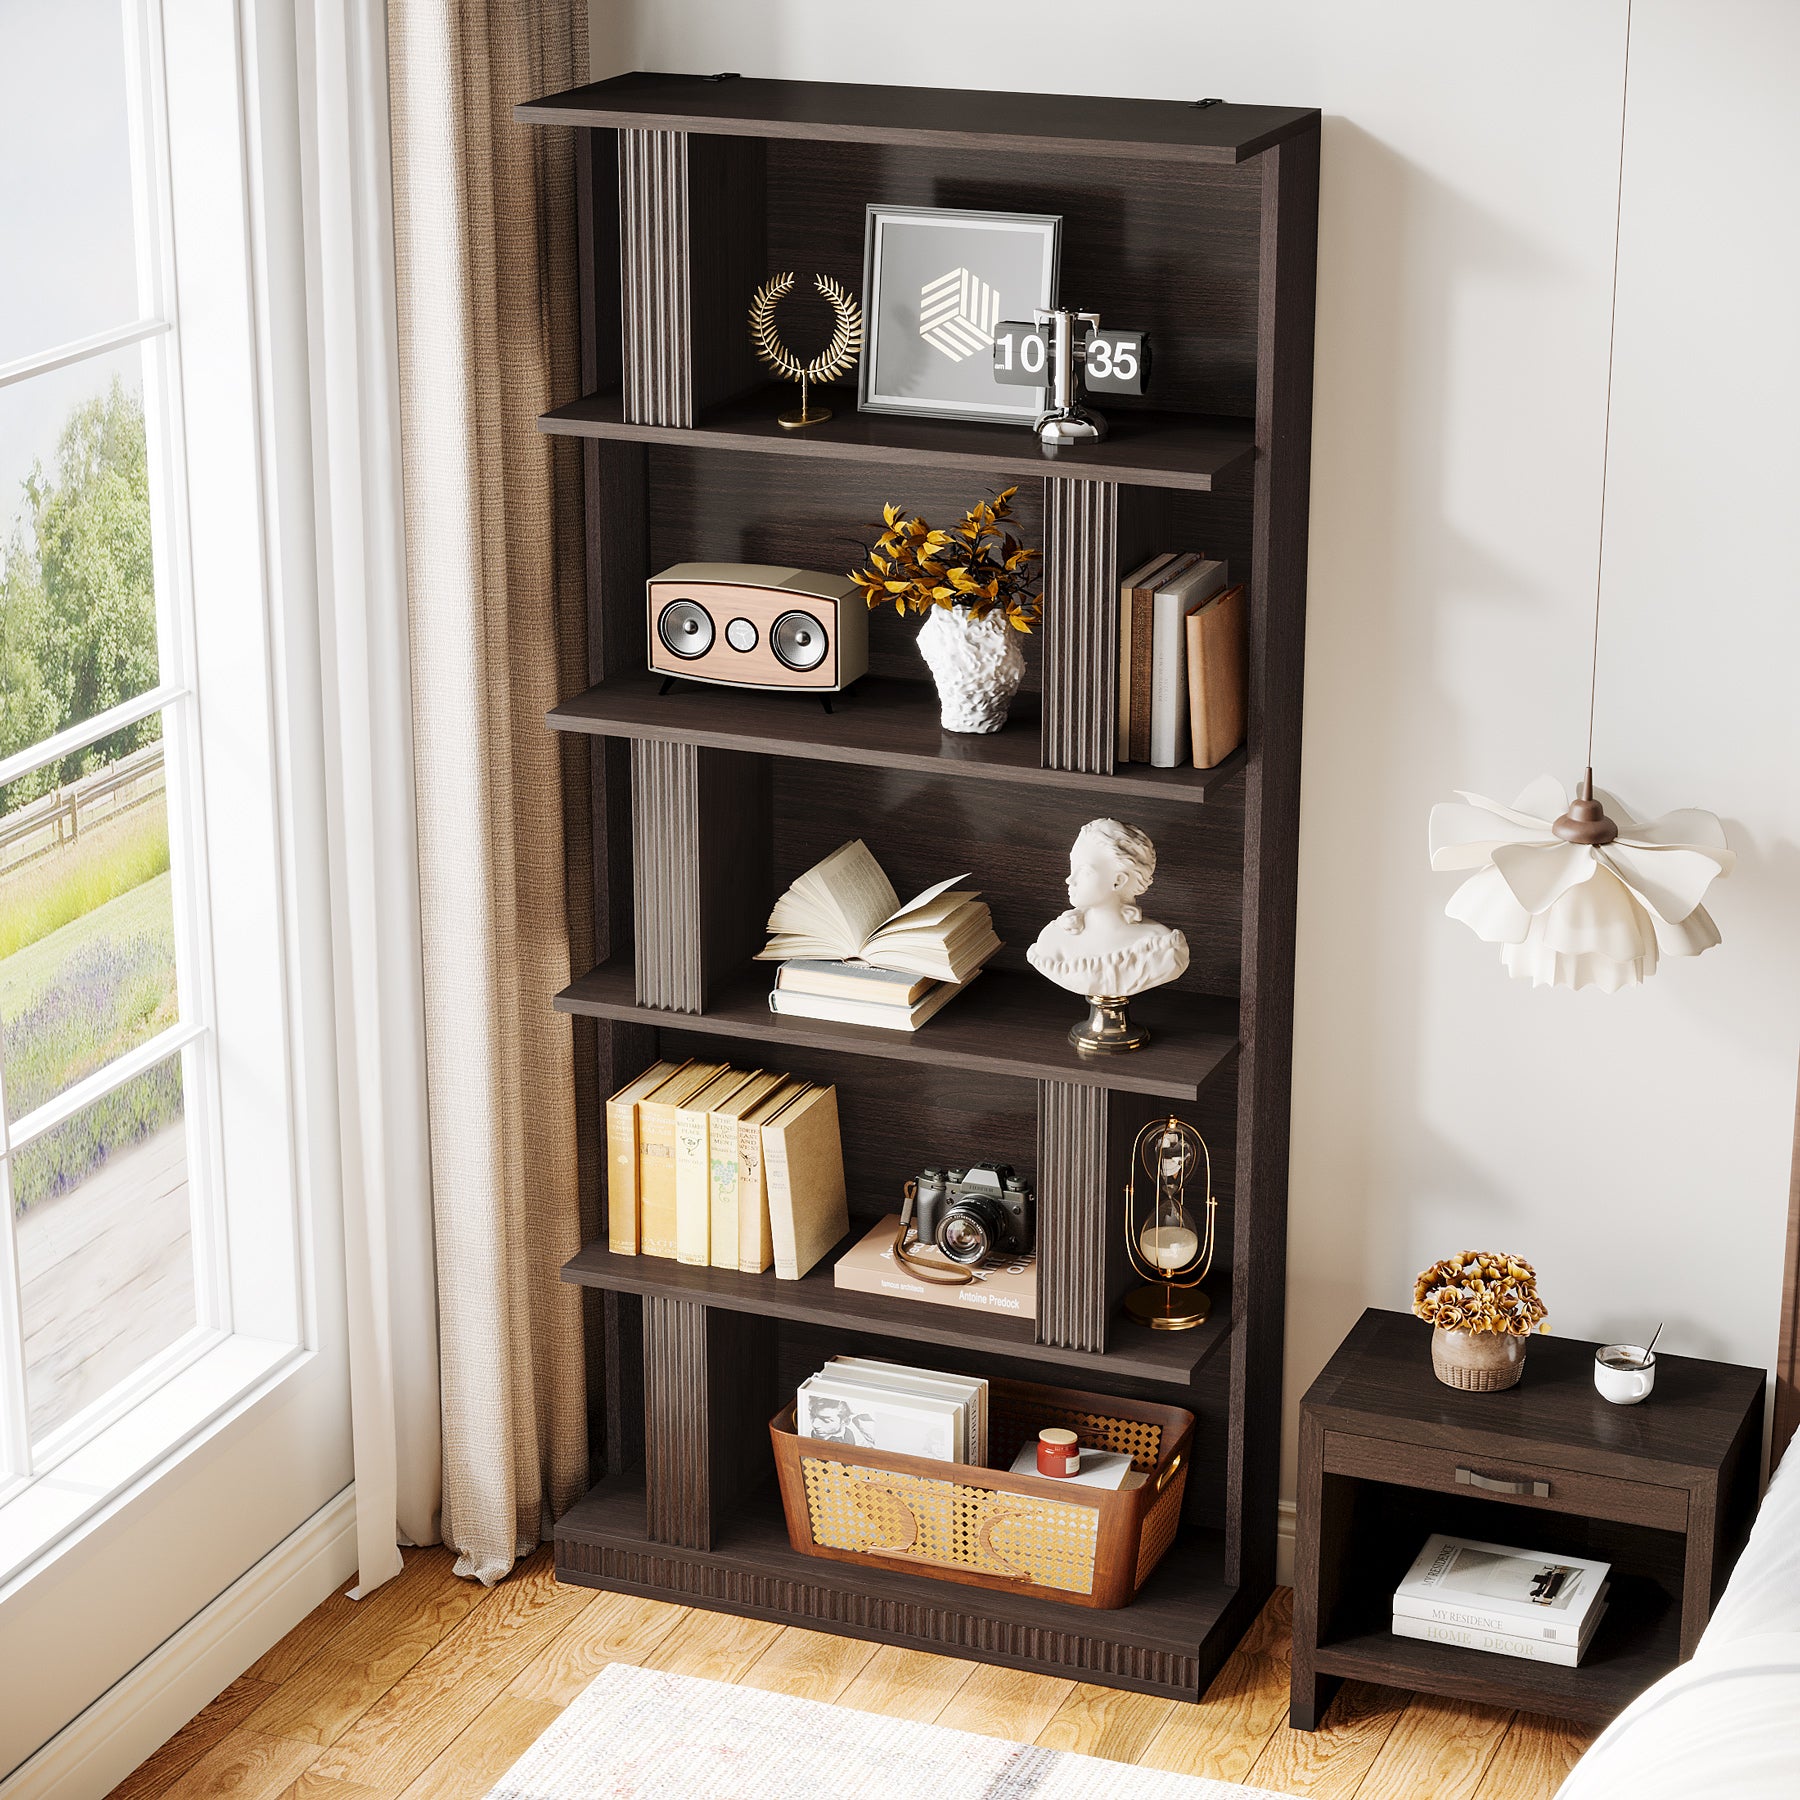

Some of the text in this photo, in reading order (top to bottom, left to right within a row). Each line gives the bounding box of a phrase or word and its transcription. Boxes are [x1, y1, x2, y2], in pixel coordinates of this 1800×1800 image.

[996, 333, 1138, 380] 10 35
[958, 1289, 1020, 1309] Antoine Predock
[1427, 1543, 1456, 1577] RESIDENCE
[1432, 1609, 1503, 1630] MY RESIDENCE
[1426, 1626, 1535, 1656] HOME DECOR
